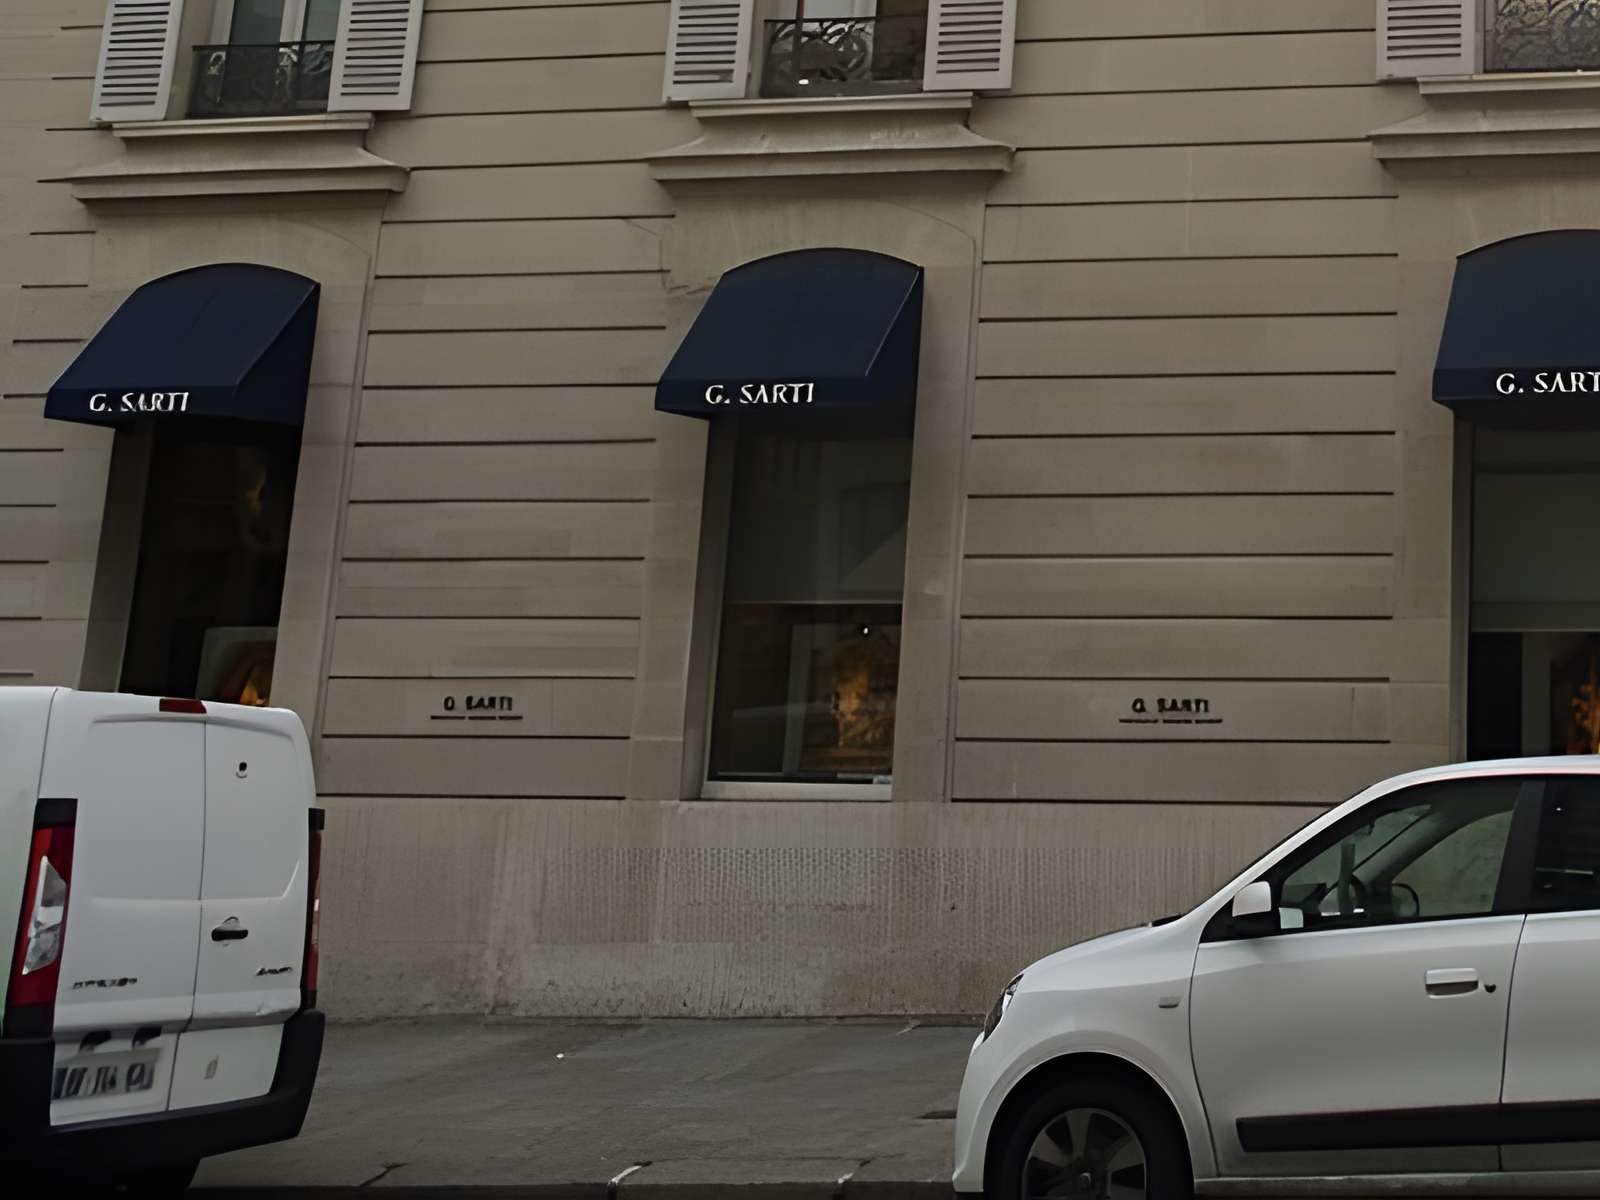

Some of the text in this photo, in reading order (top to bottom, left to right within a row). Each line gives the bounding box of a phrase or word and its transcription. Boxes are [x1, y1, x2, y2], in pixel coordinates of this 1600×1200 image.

[705, 382, 815, 405] G. SARTI
[1496, 372, 1524, 395] G.
[89, 391, 189, 412] G. SARTI
